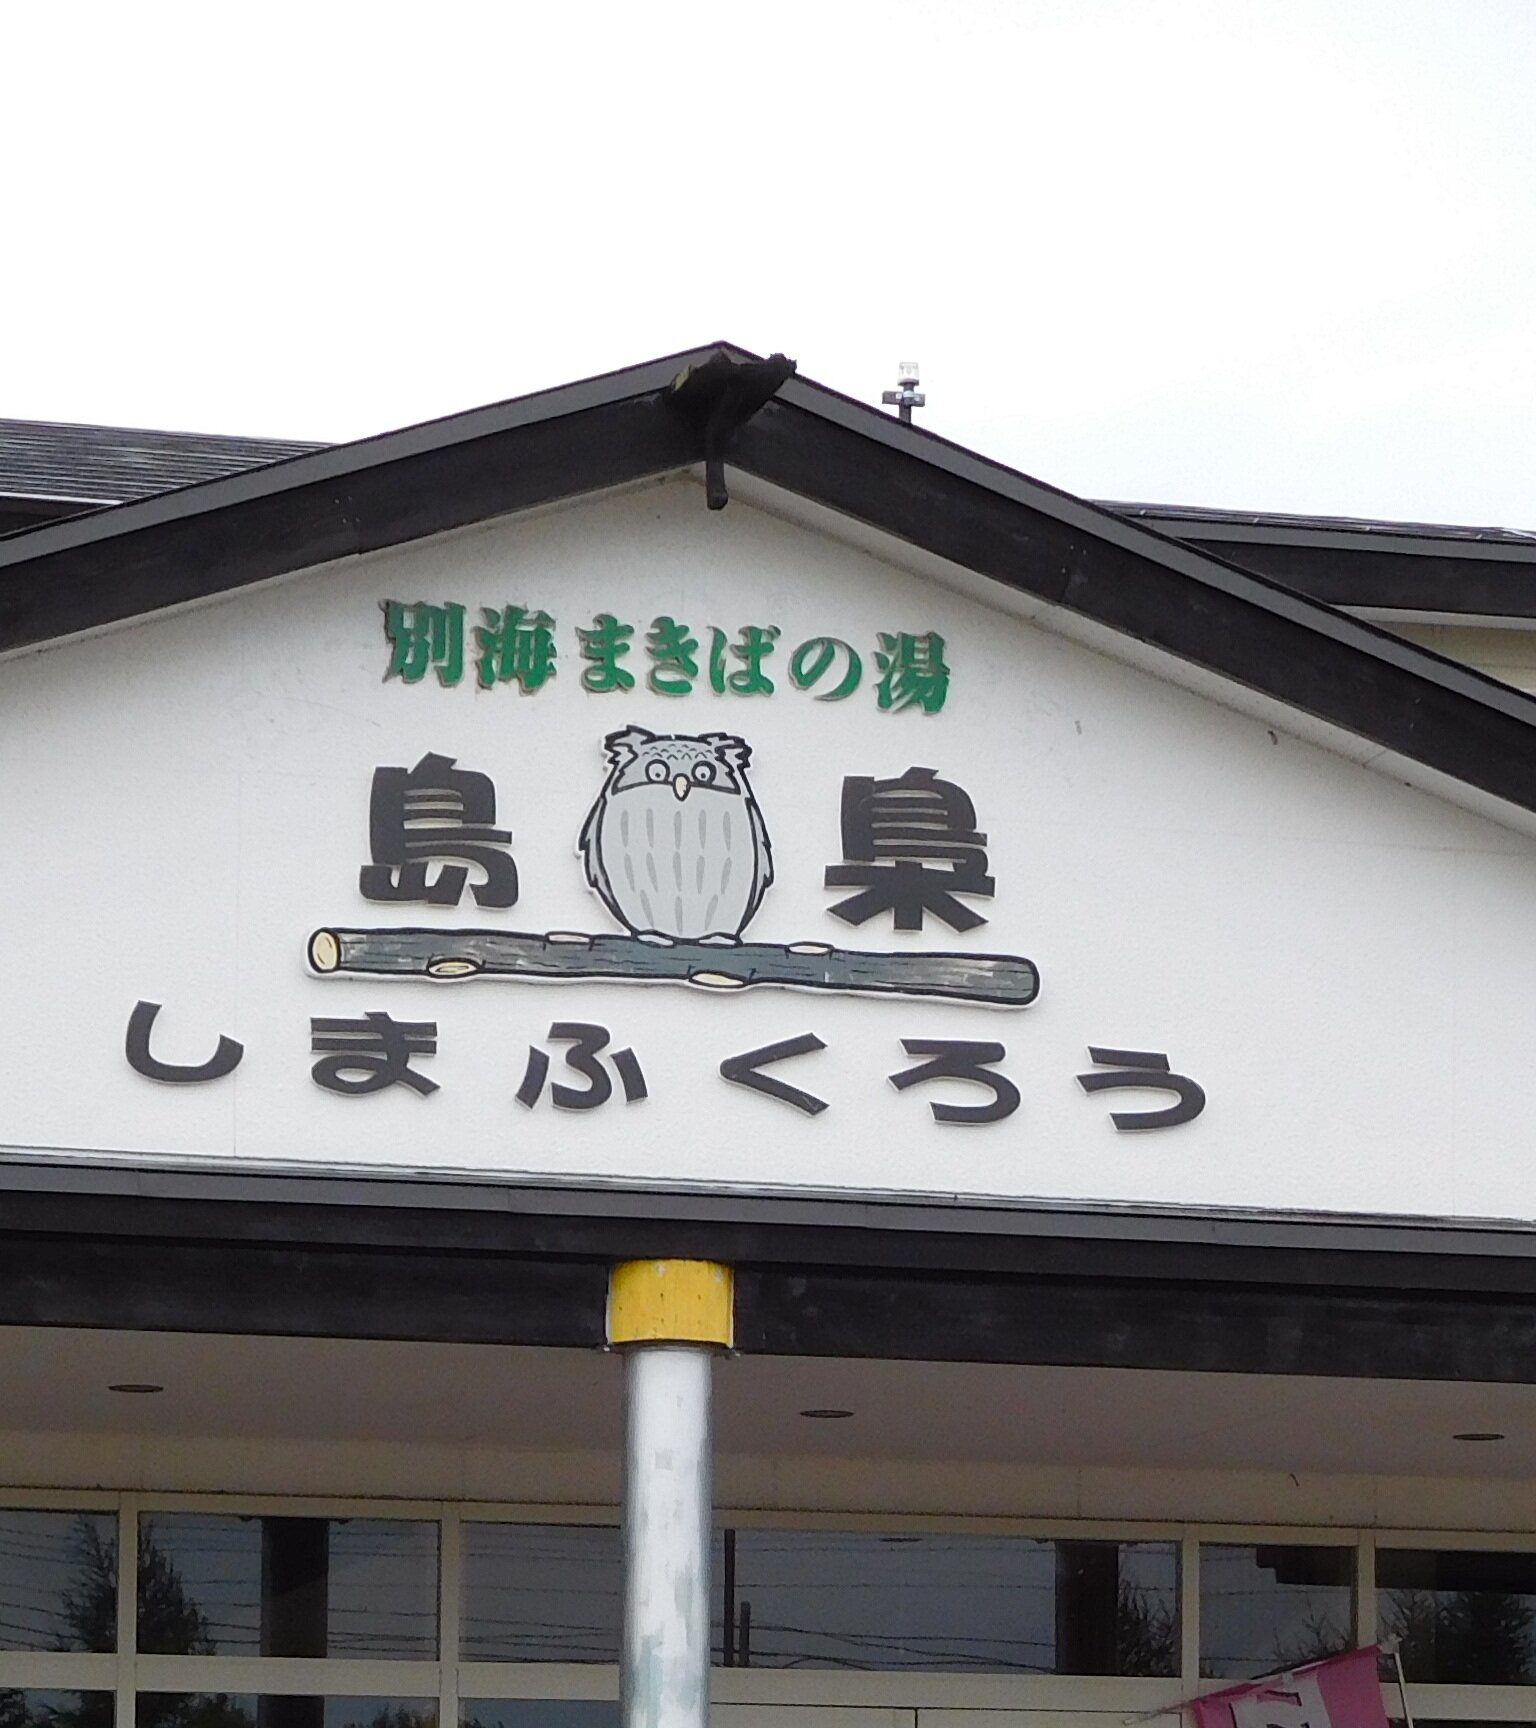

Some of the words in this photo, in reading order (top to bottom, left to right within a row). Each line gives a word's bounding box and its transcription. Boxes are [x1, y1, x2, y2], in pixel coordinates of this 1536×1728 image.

[378, 599, 952, 715] 別海まきばの湯
[357, 752, 521, 909] 島
[124, 1000, 1208, 1134] しまふくろう
